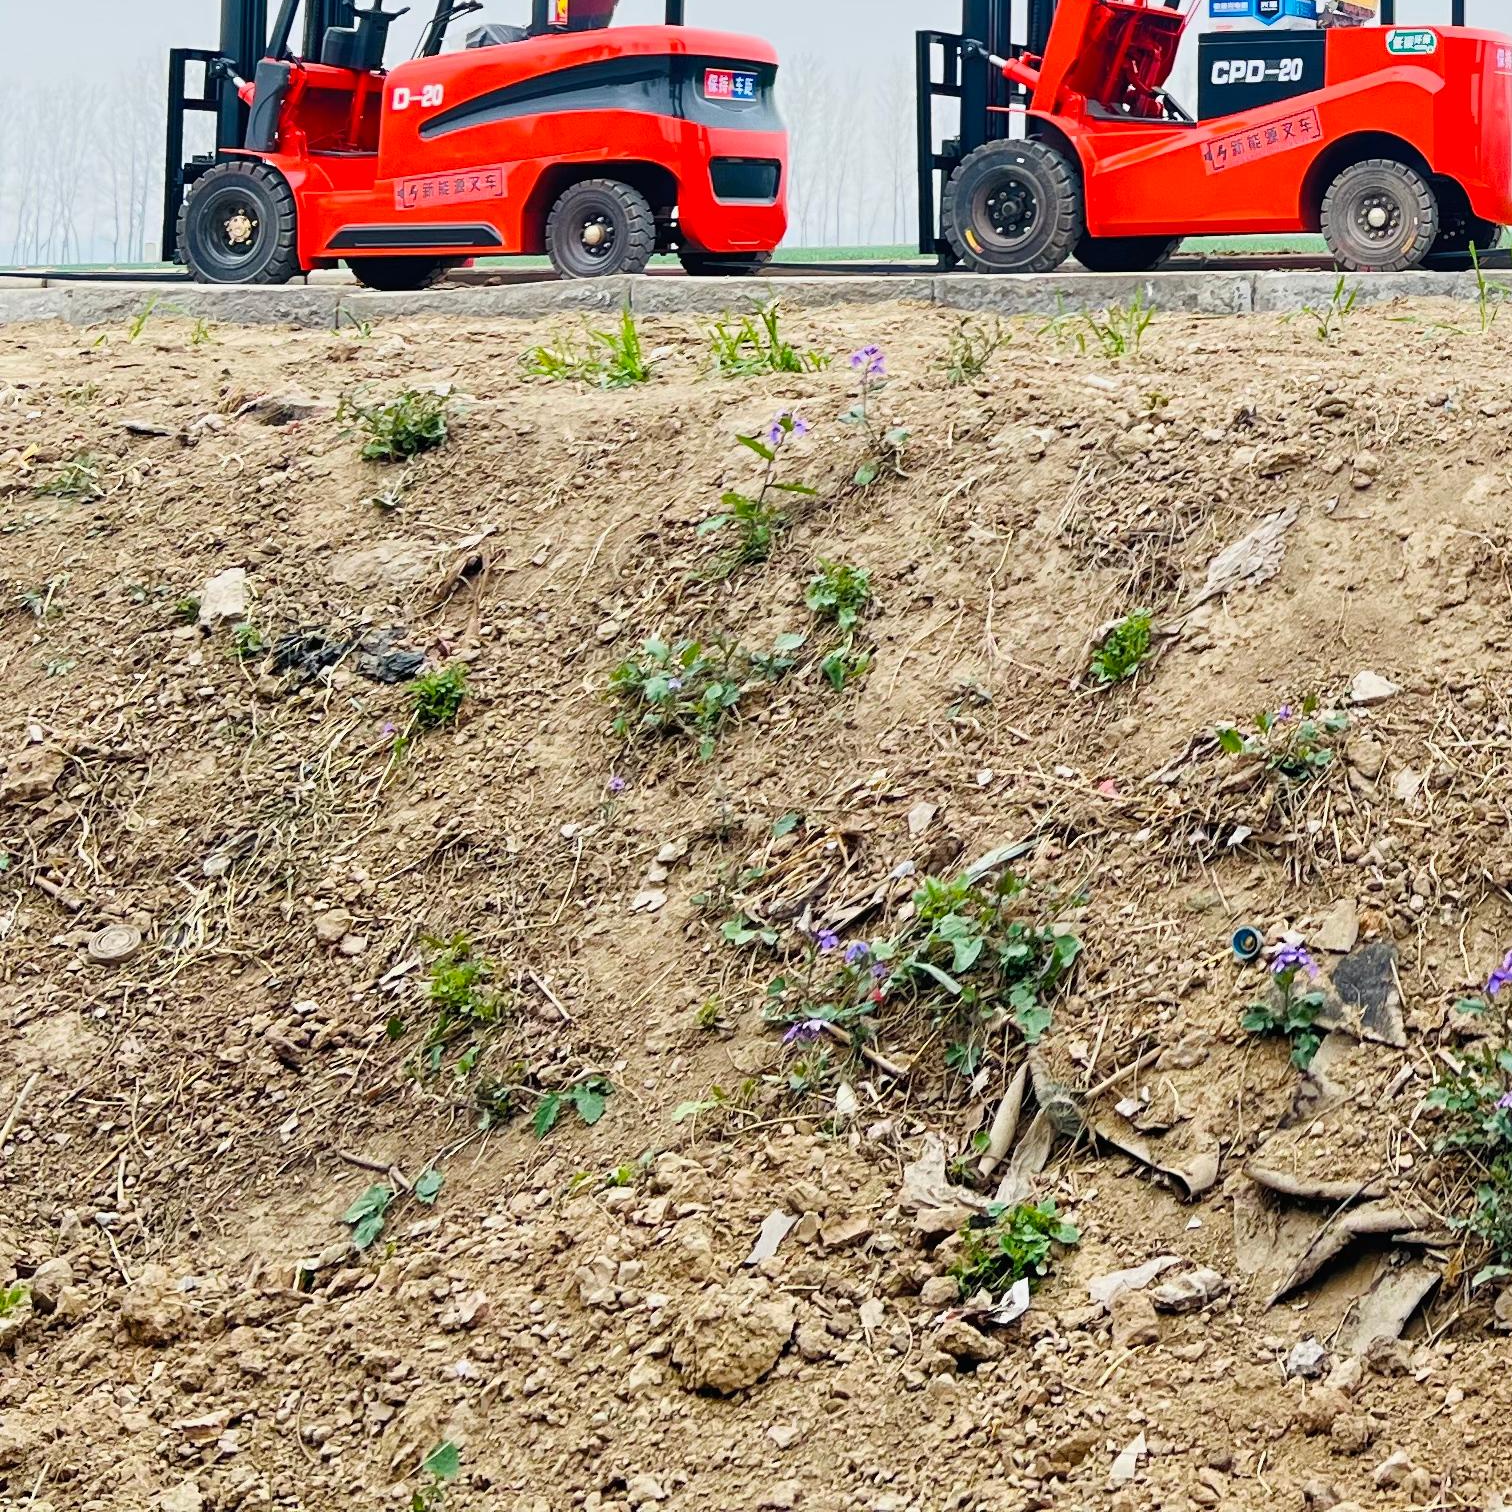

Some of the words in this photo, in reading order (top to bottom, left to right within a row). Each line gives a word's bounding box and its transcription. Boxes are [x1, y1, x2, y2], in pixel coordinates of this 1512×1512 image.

[1211, 58, 1303, 84] CPD-20
[392, 83, 444, 110] D-20
[1231, 117, 1313, 156] 新能源叉车
